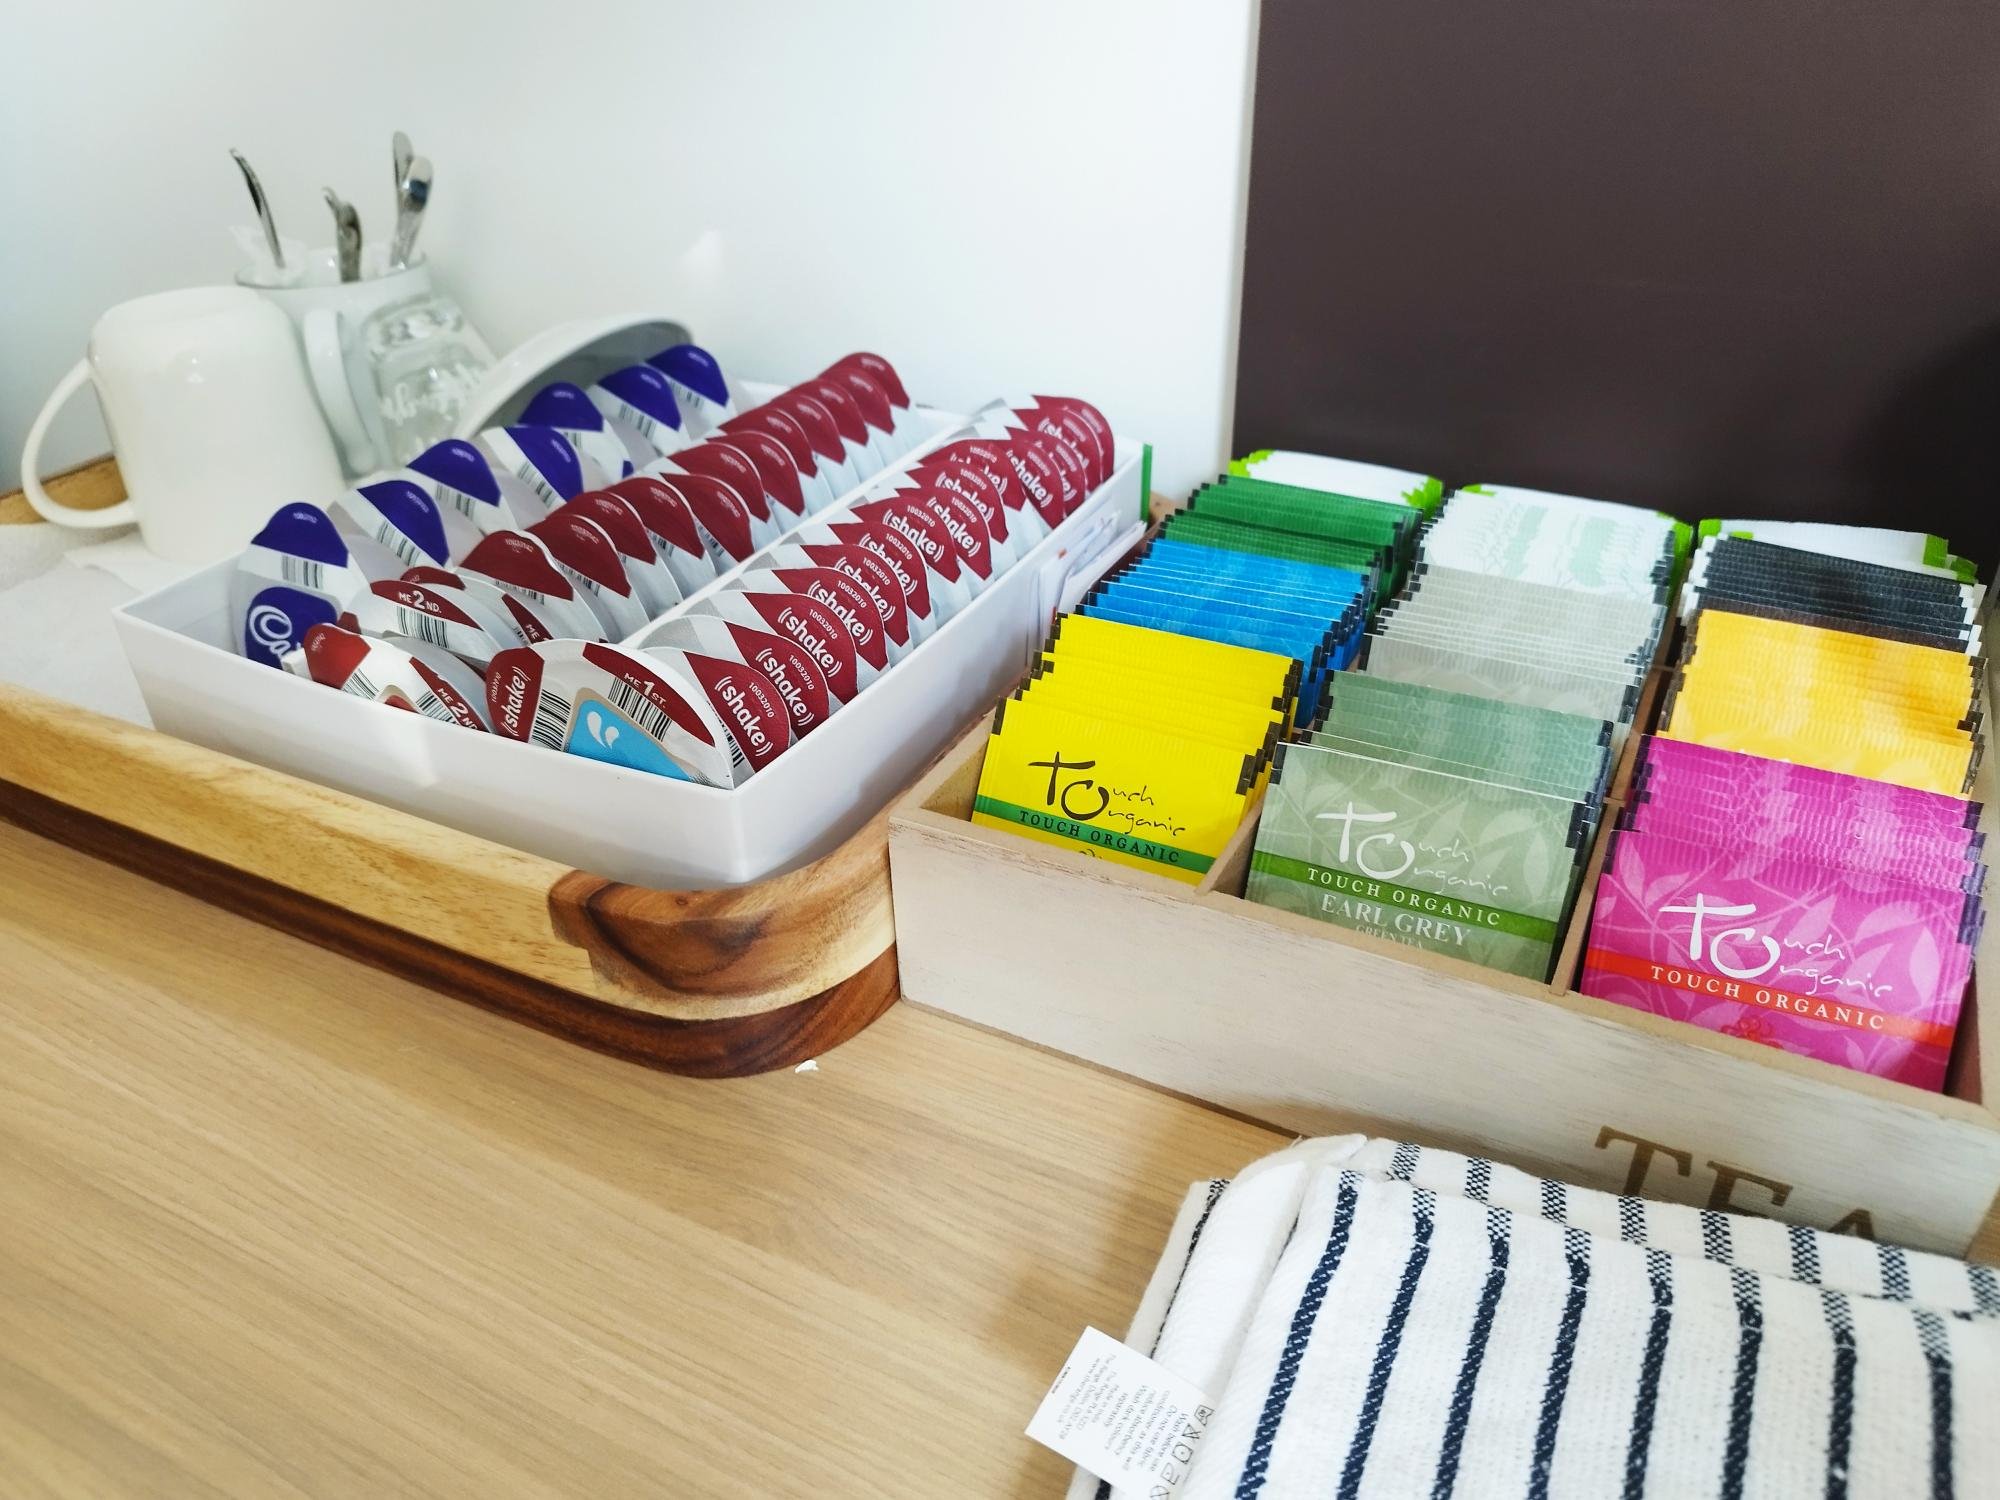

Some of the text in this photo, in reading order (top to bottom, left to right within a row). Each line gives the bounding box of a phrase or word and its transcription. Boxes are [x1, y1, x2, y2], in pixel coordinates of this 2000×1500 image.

[906, 505, 936, 528] 10032010
[885, 533, 913, 561] 10032010
[862, 557, 890, 586] 10032010
[837, 580, 867, 608] 10032010
[809, 608, 838, 640] 10032010
[623, 672, 641, 688] ME
[789, 654, 814, 690] 10032010
[749, 682, 775, 718] 10032010
[1020, 810, 1080, 837] TOUCH
[1090, 831, 1180, 863] ORGANIC
[1308, 867, 1500, 926] TOUCH ORGANIC
[1321, 893, 1471, 946] EARL GREY
[1650, 965, 1884, 1030] TOUCH ORGANIC
